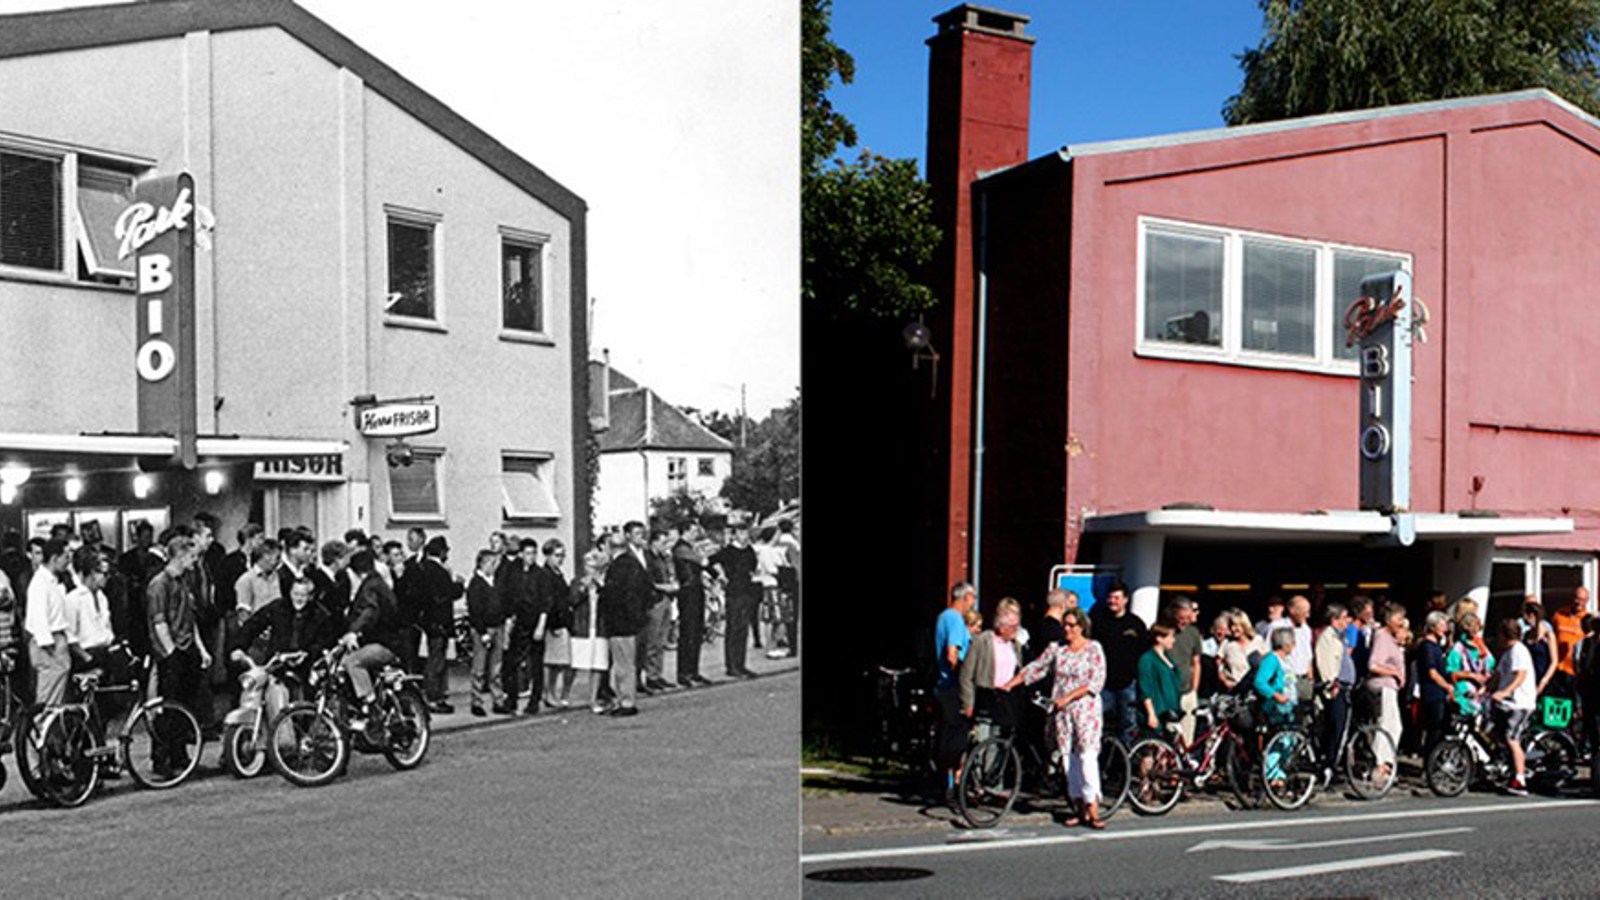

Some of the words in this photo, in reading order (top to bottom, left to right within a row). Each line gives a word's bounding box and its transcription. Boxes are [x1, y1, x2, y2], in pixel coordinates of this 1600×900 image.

[114, 188, 193, 261] Park
[137, 253, 175, 381] BIO
[1343, 284, 1406, 348] Park
[1362, 343, 1390, 459] BIO
